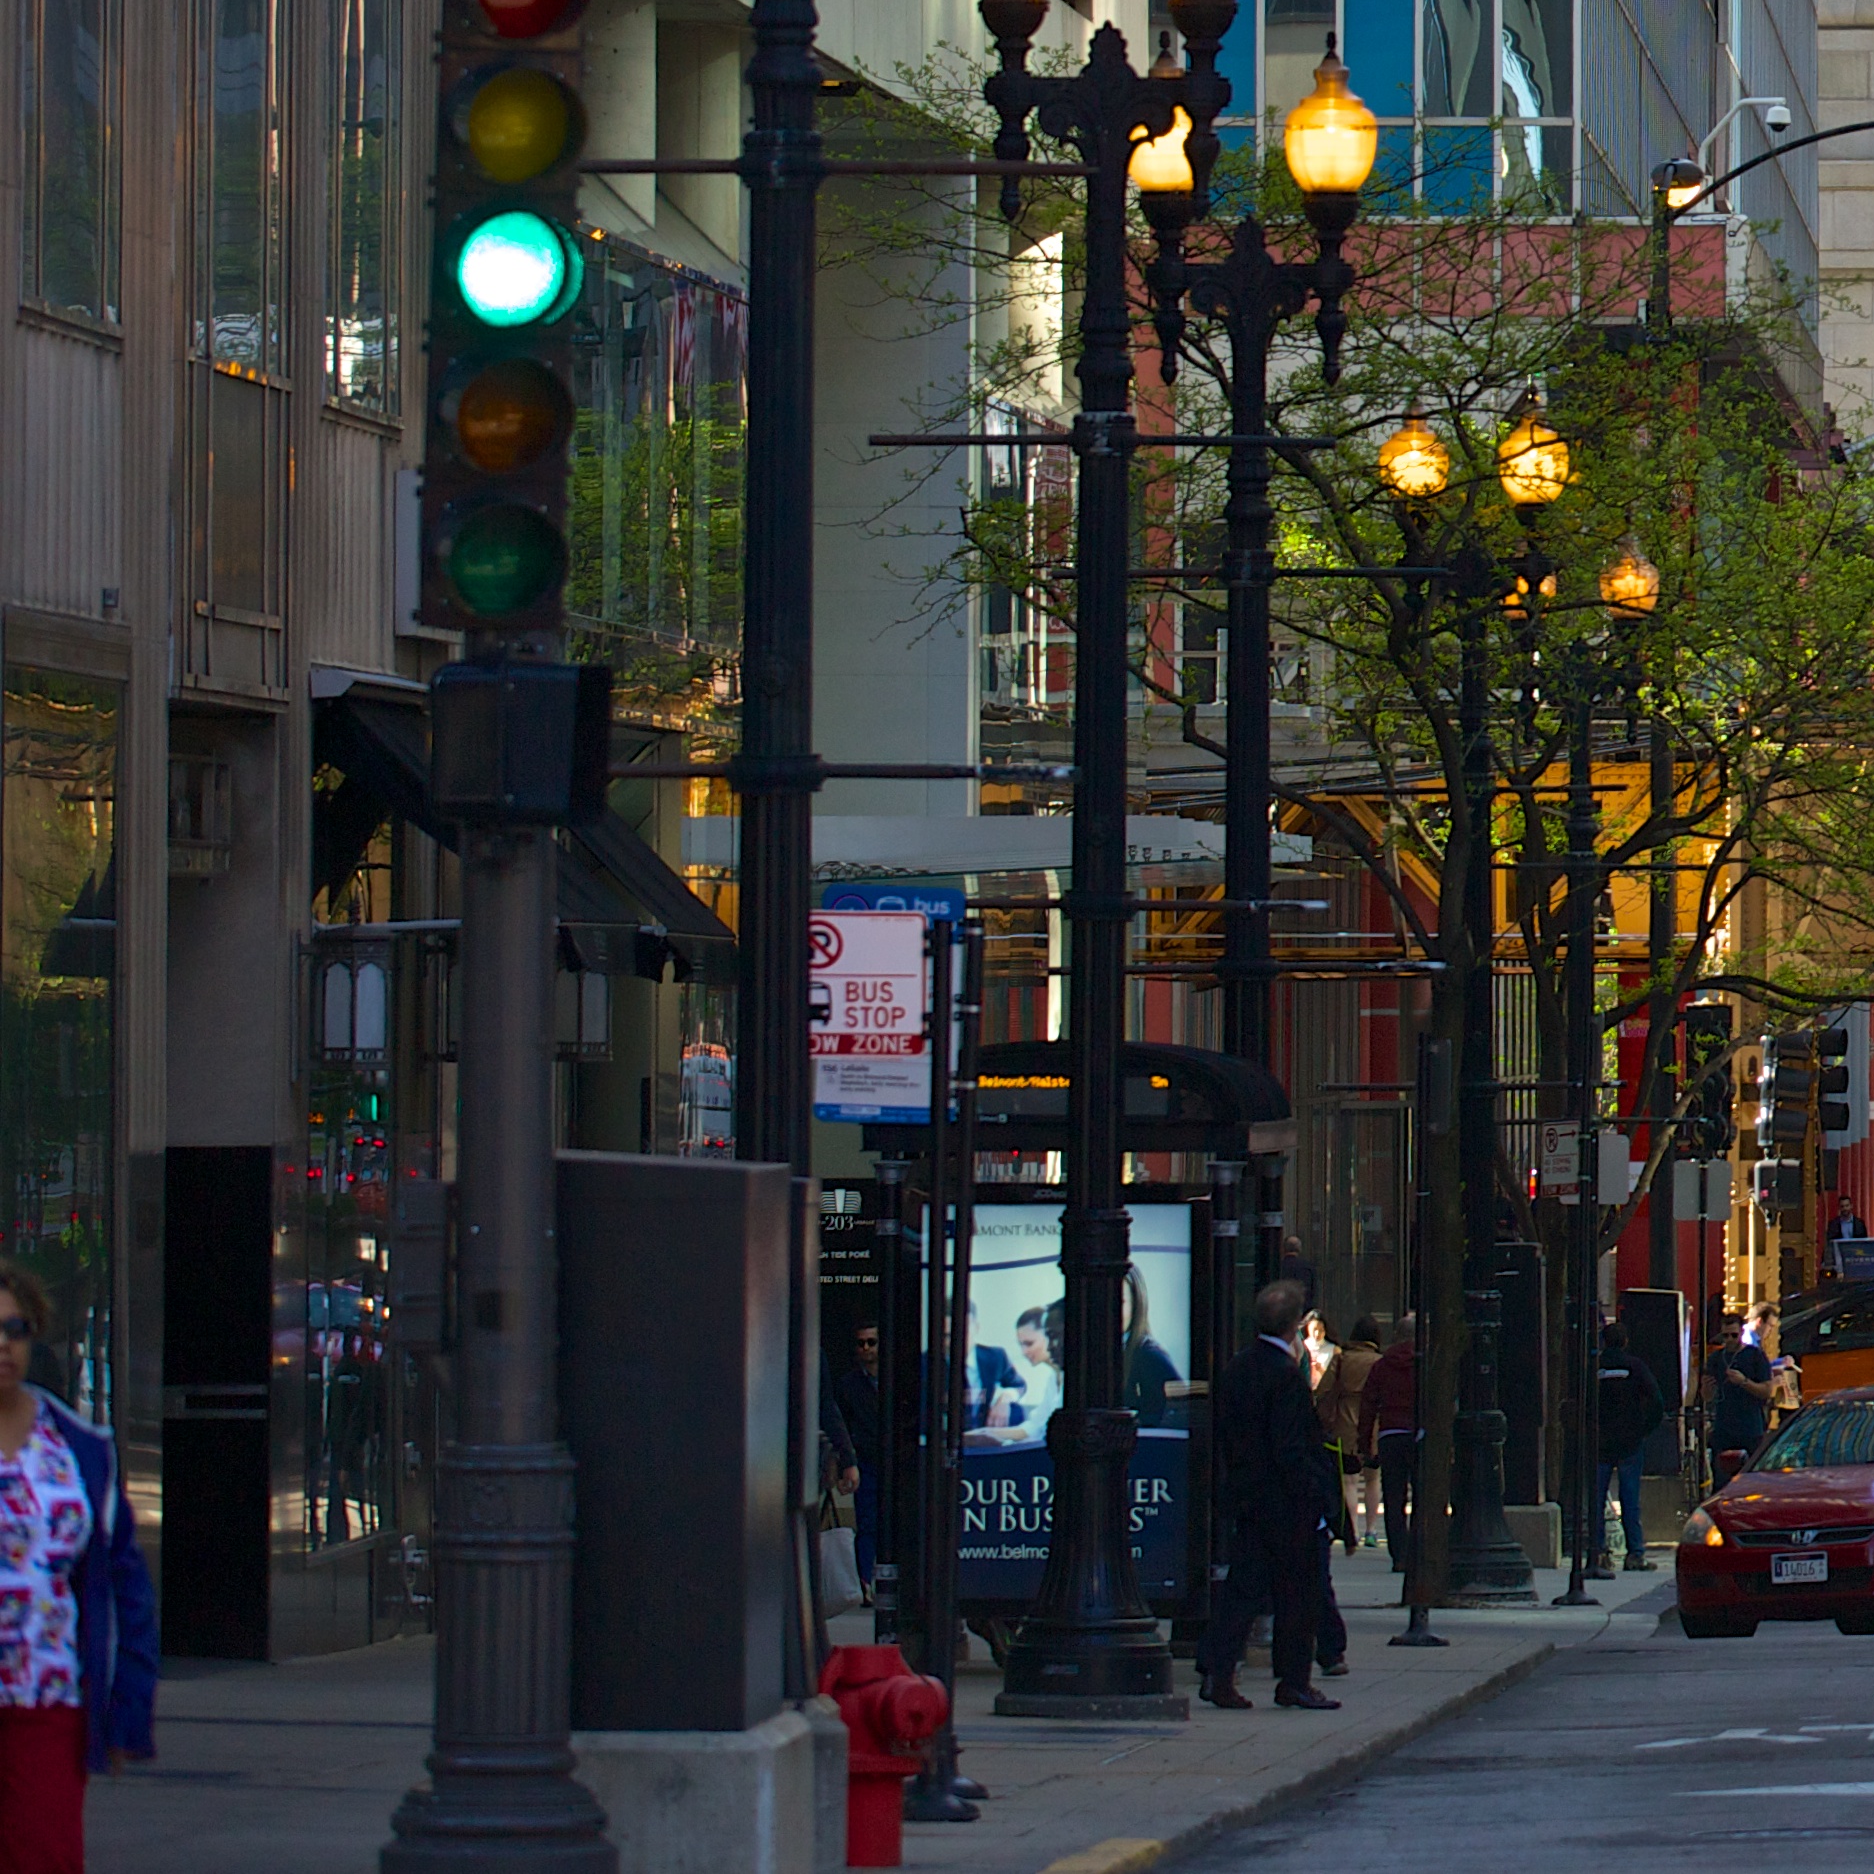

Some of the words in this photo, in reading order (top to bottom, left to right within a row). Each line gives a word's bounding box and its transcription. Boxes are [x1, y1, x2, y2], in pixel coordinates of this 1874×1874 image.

[913, 897, 950, 914] bus
[845, 981, 893, 1003] BUS
[844, 1006, 906, 1028] STOP
[809, 1035, 840, 1053] OW
[853, 1035, 914, 1053] ZONE
[824, 1215, 854, 1231] 203
[831, 1251, 847, 1259] TIDE
[848, 1249, 871, 1259] POKÉ
[834, 1275, 860, 1283] STREET
[862, 1275, 879, 1283] DELI
[959, 1479, 1022, 1504] OUR
[963, 1507, 987, 1532] N
